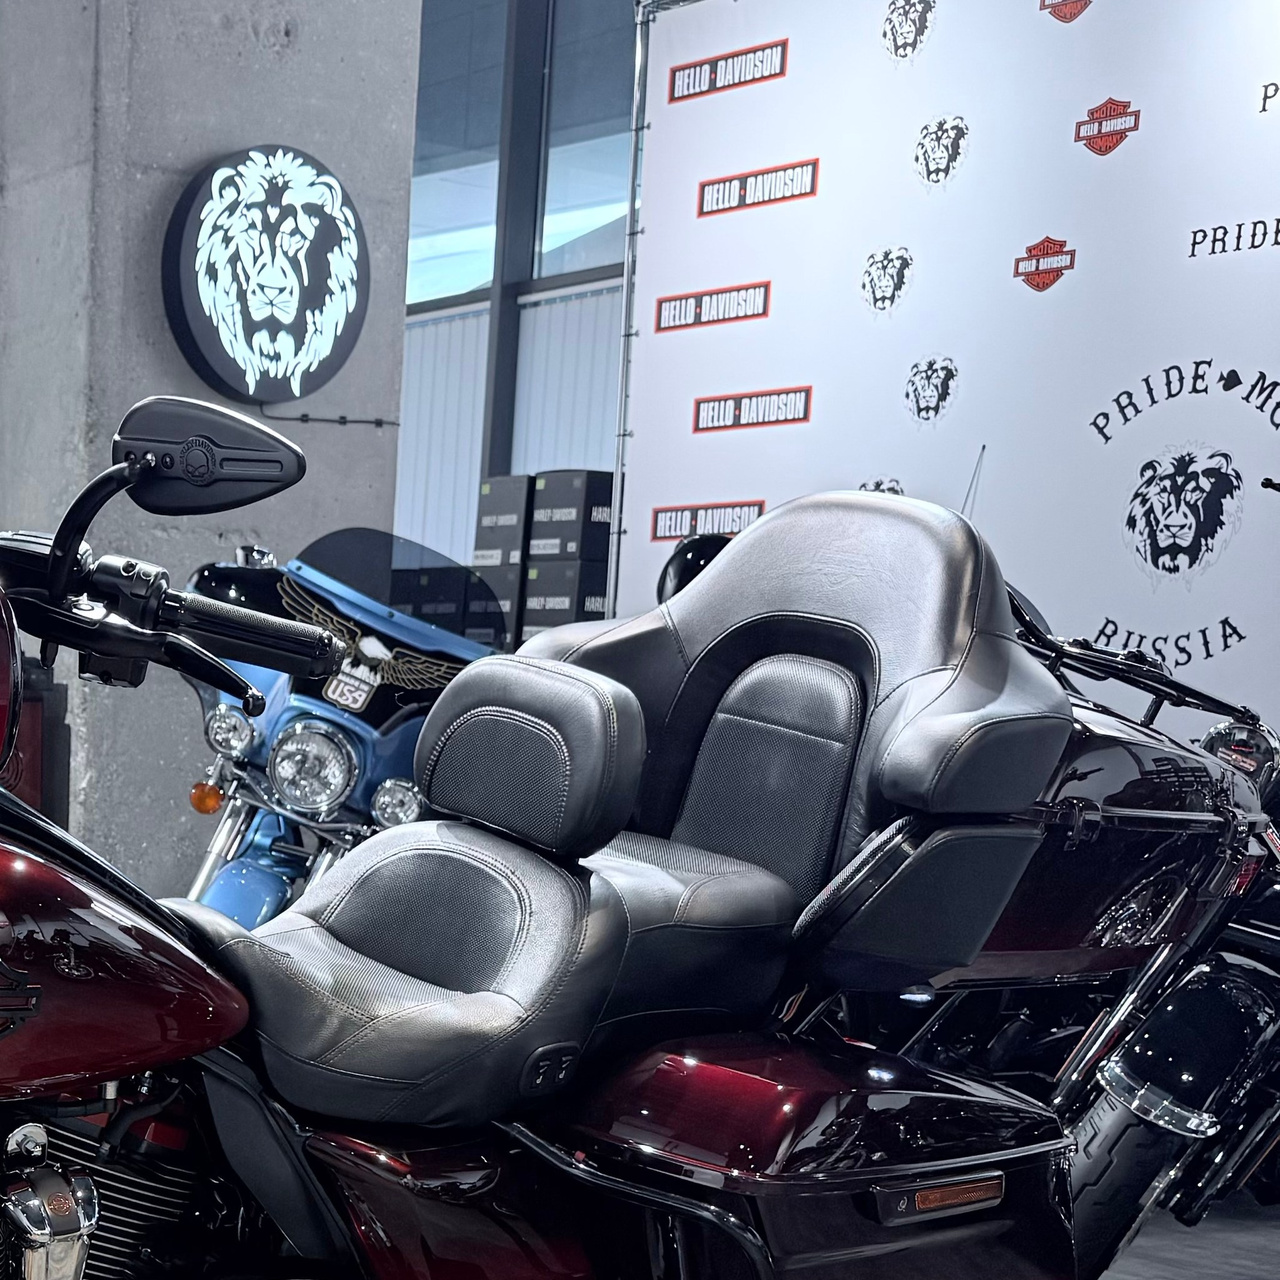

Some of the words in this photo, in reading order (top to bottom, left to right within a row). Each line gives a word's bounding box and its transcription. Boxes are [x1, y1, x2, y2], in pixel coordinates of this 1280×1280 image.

[1092, 103, 1124, 119] MOTOR
[1031, 241, 1061, 256] MOTOR
[1089, 358, 1213, 445] PRIDE
[1094, 616, 1247, 669] RUSSIA
[327, 679, 368, 709] USA
